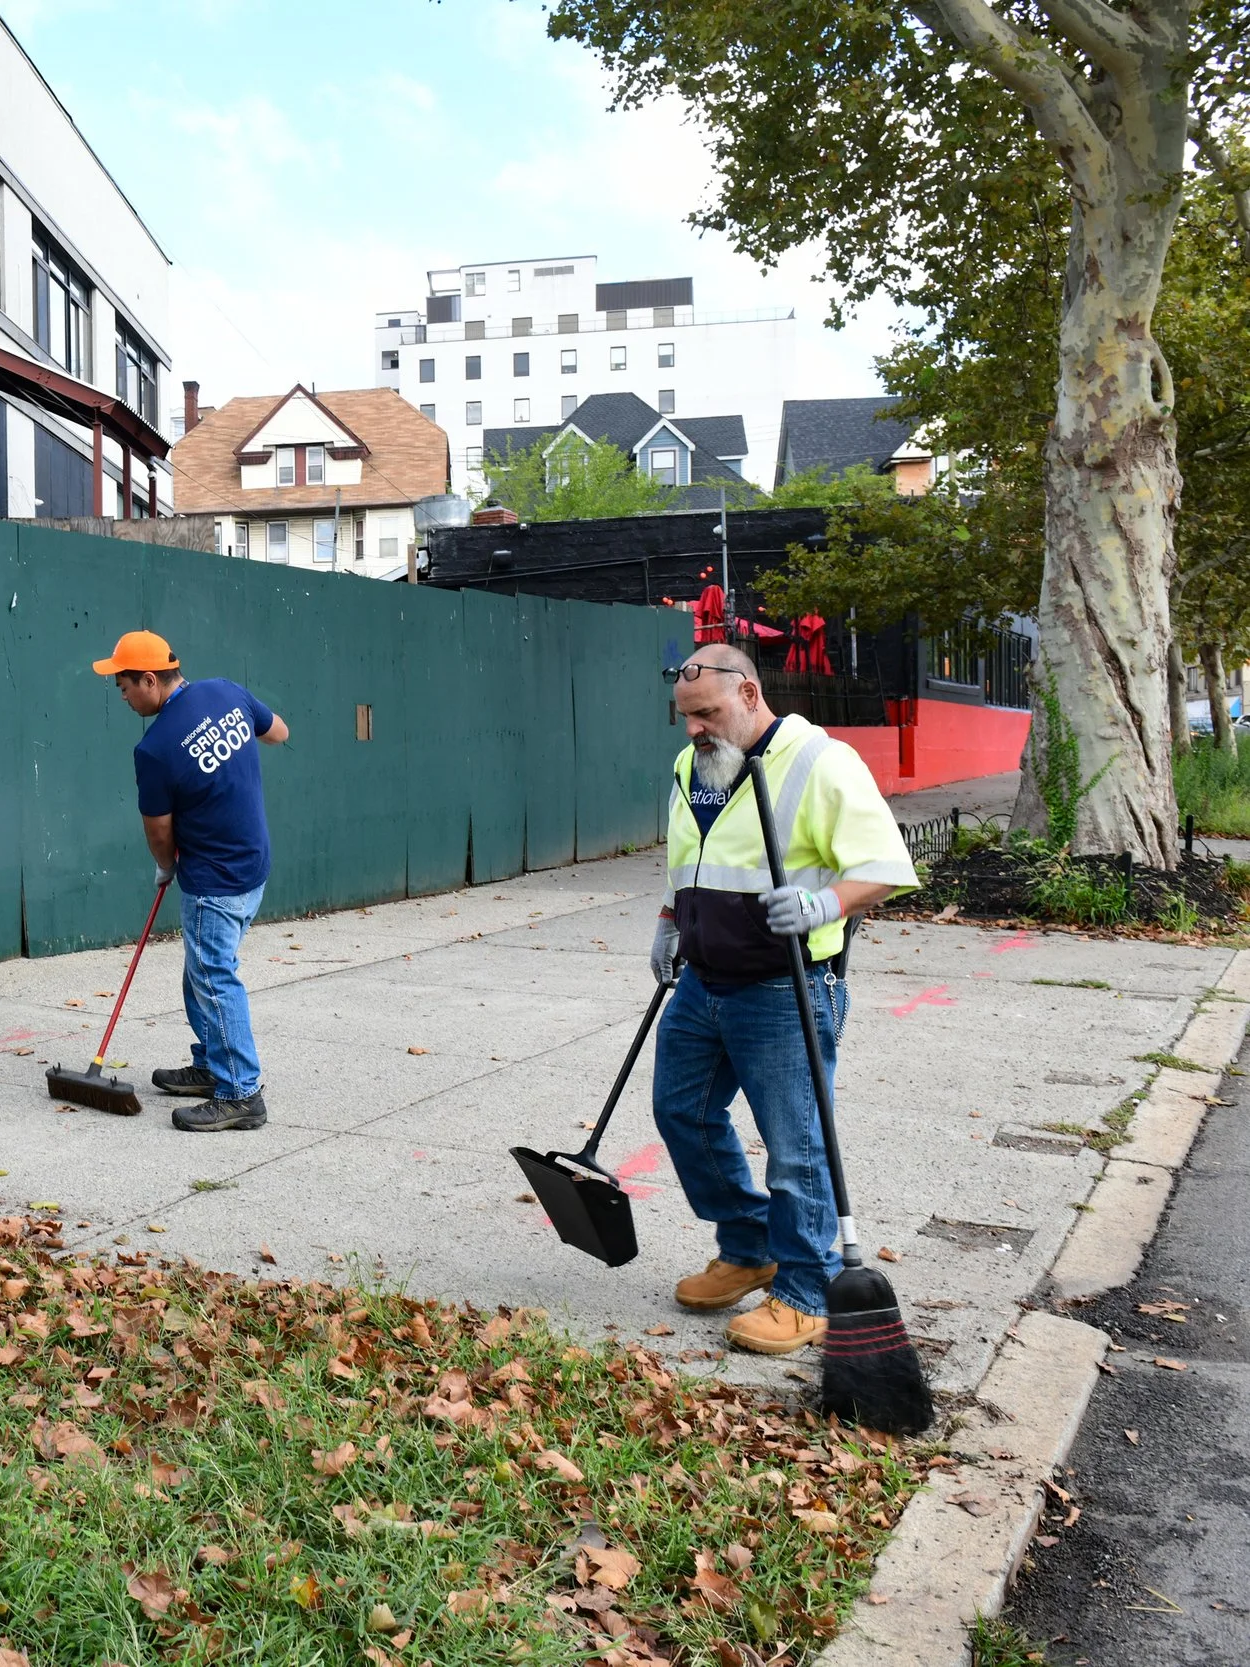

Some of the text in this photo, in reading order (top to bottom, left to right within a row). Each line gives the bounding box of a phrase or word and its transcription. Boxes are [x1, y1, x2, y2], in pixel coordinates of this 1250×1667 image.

[180, 716, 212, 748] nationalgrid
[188, 707, 244, 758] GRID FOR
[198, 721, 251, 774] GOOD
[690, 789, 731, 806] ational
